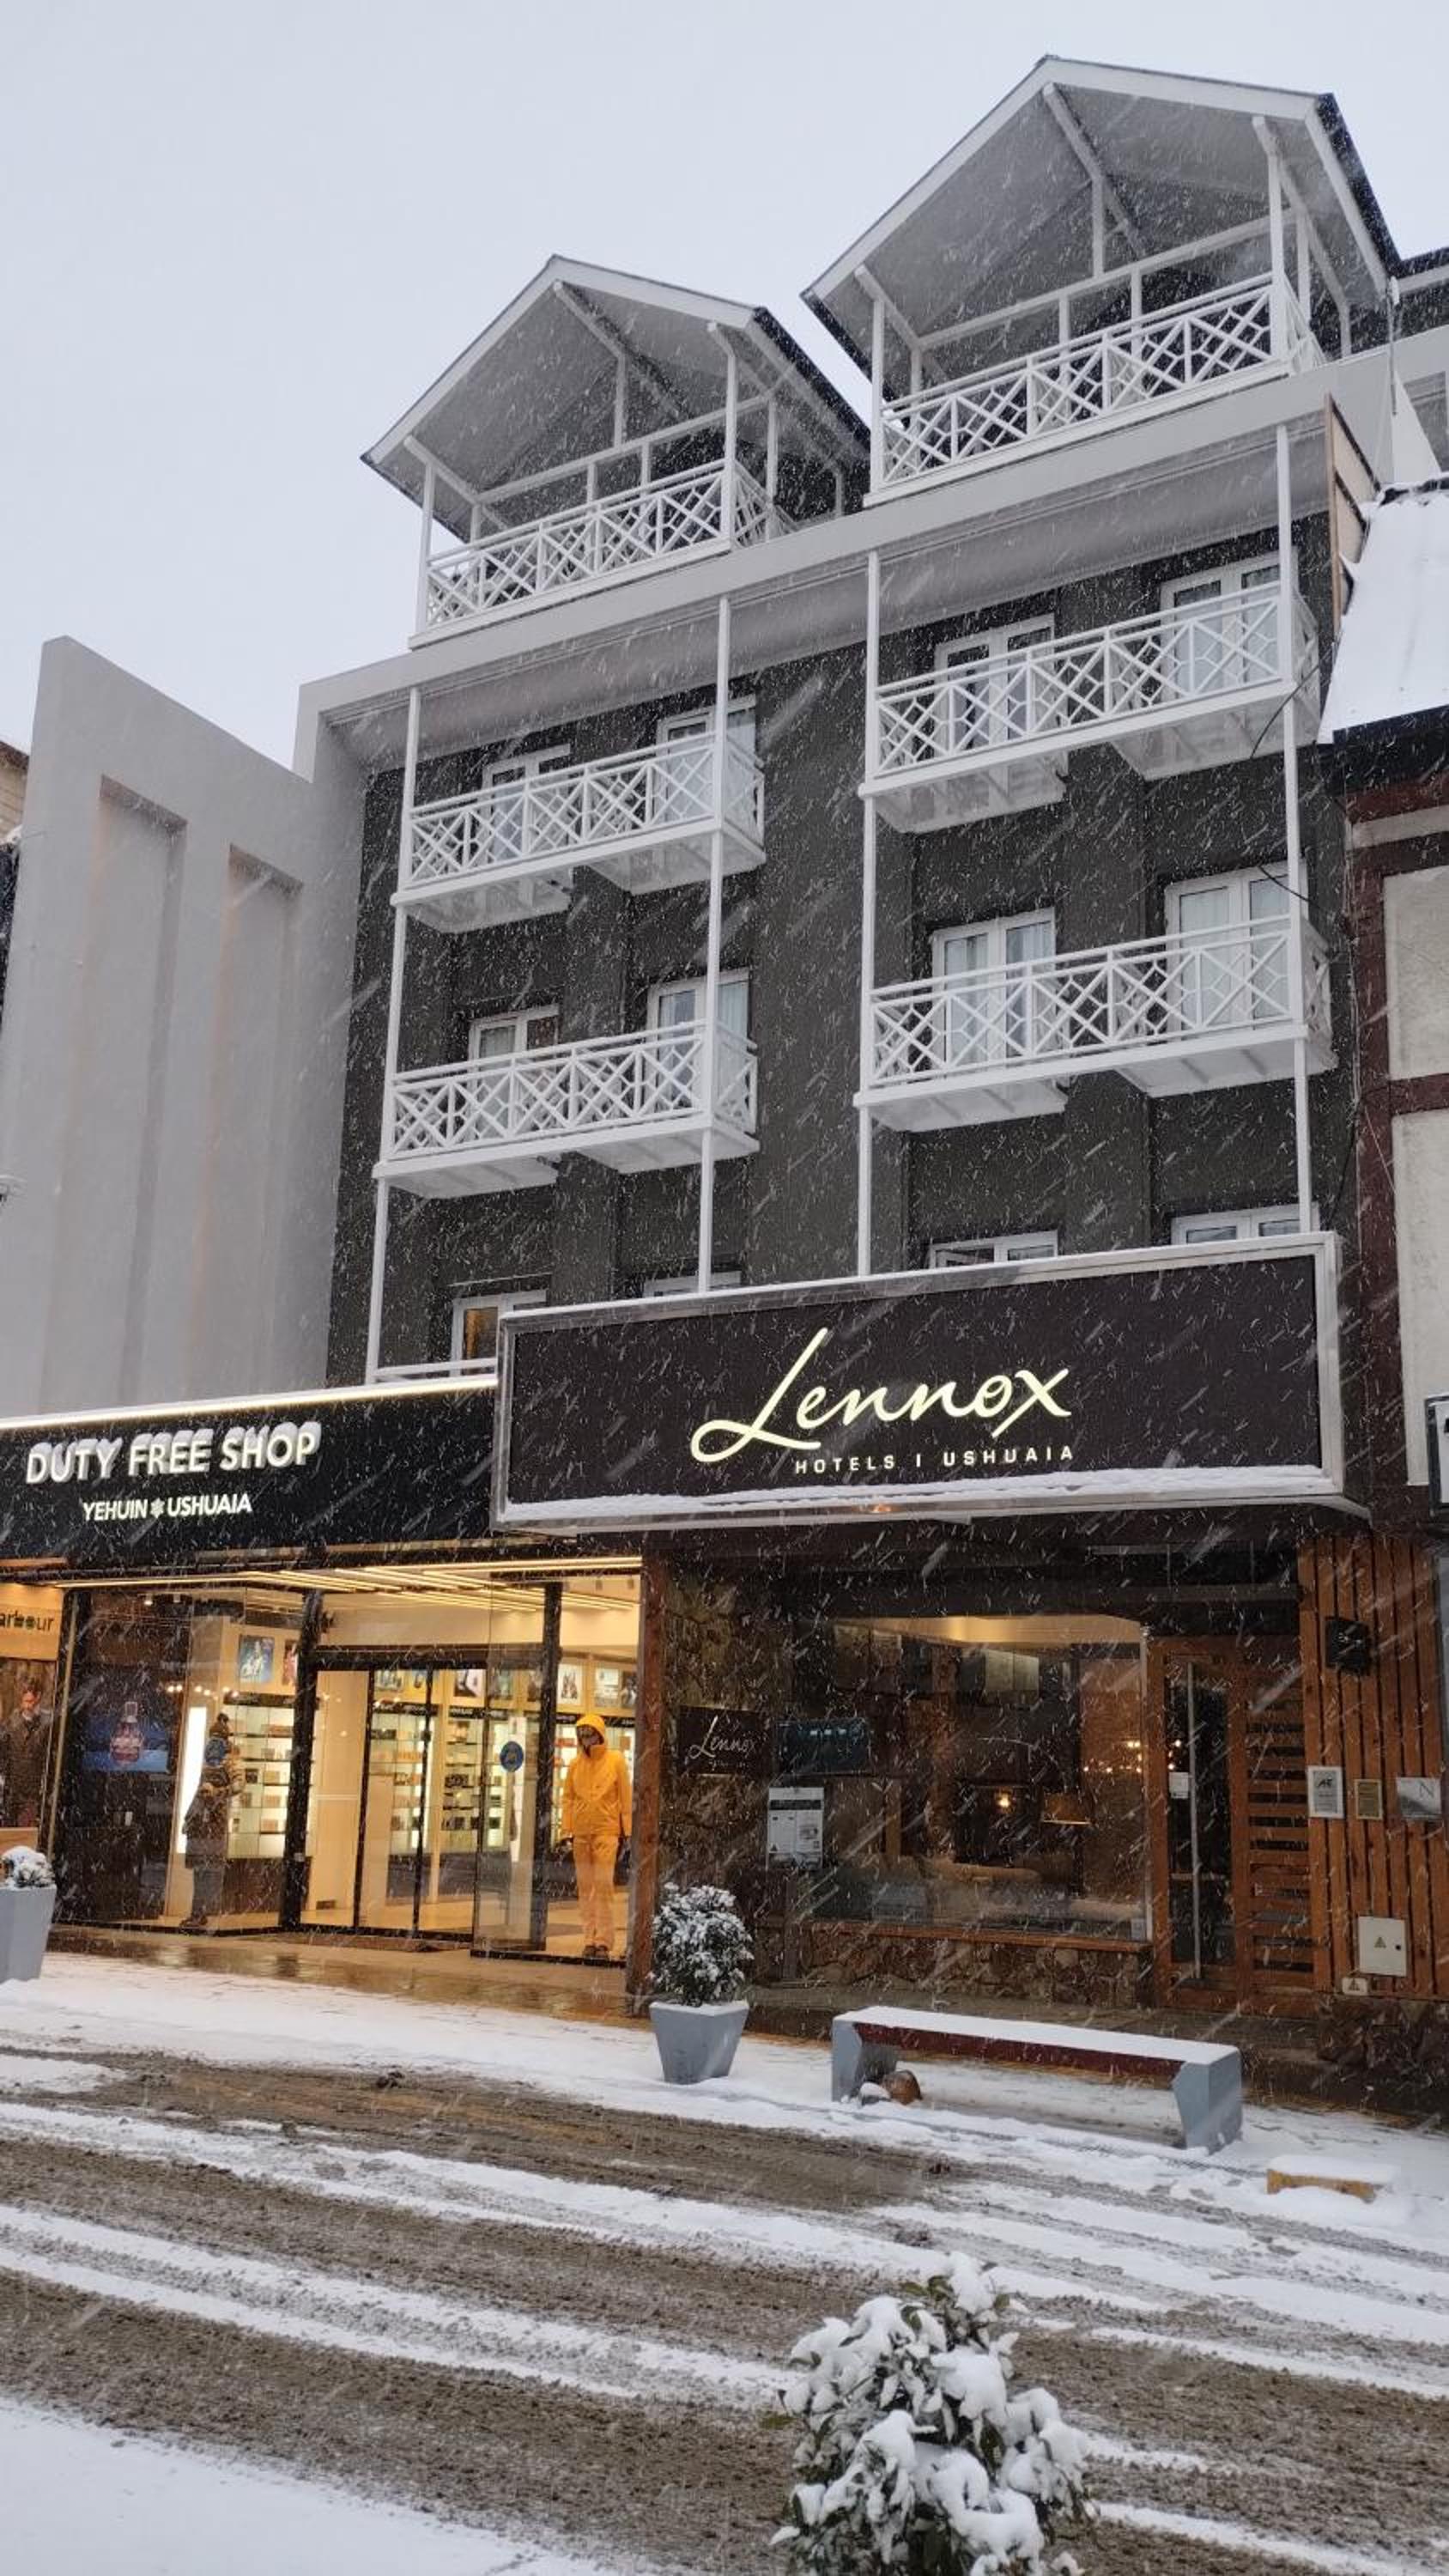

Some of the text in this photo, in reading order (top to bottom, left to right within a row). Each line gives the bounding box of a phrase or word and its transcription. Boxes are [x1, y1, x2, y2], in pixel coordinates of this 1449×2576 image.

[690, 1327, 1072, 1462] Lennox
[26, 1421, 322, 1484] DUTY FREE SHOP
[795, 1454, 895, 1474] HOTELS
[943, 1445, 1073, 1467] USHUAIA
[83, 1492, 253, 1522] YEHUIN USHUAIA
[688, 1714, 755, 1759] Lennox
